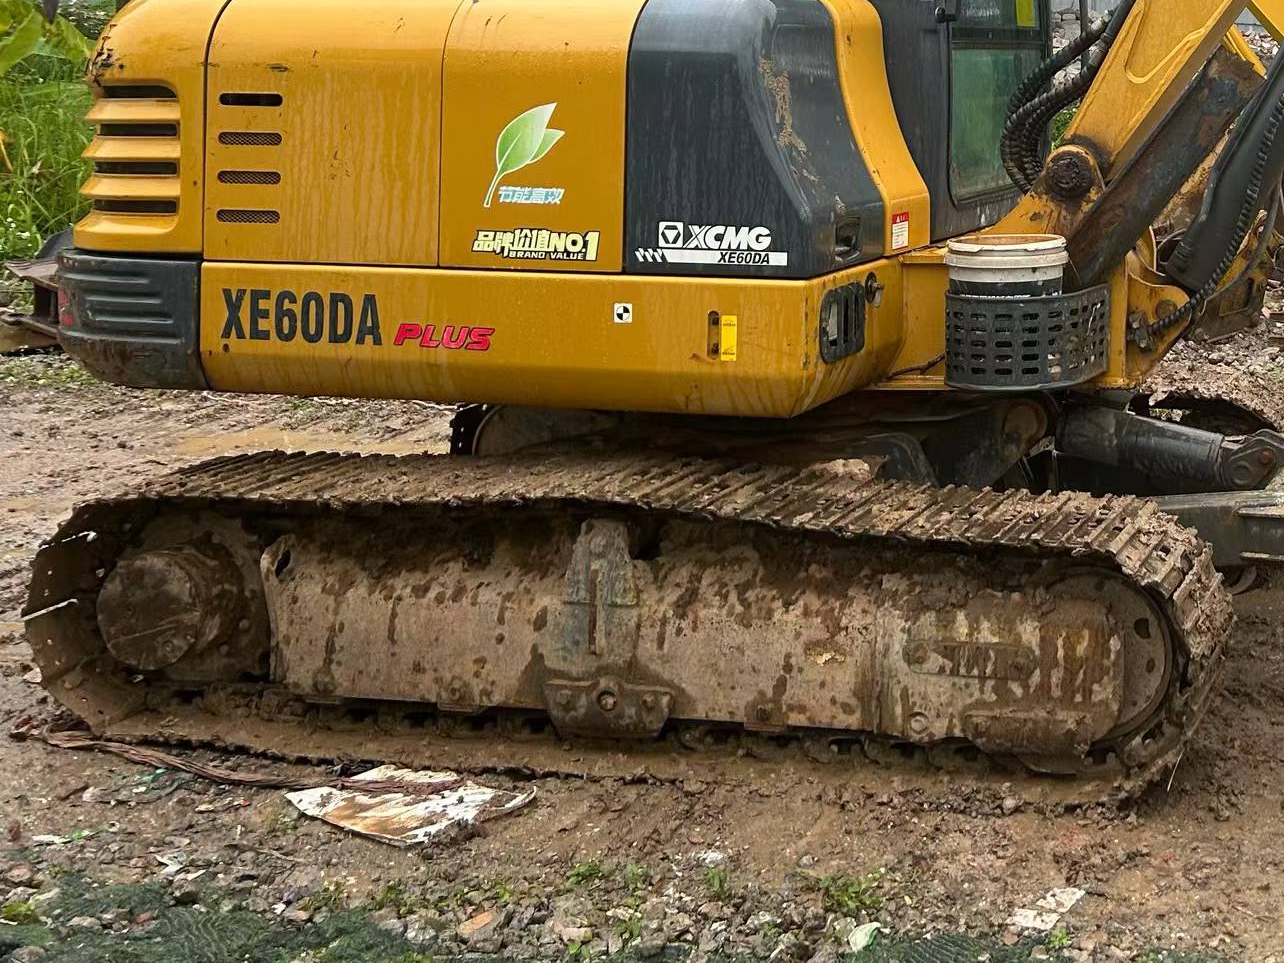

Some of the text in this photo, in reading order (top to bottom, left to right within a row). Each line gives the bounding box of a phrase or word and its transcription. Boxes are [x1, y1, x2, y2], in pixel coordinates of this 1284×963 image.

[498, 186, 565, 205] 节能高效
[683, 225, 772, 251] XCMG
[509, 250, 585, 260] BRAND VALUE
[717, 251, 770, 265] XE60DA
[220, 288, 496, 352] XE60DA PLUS
